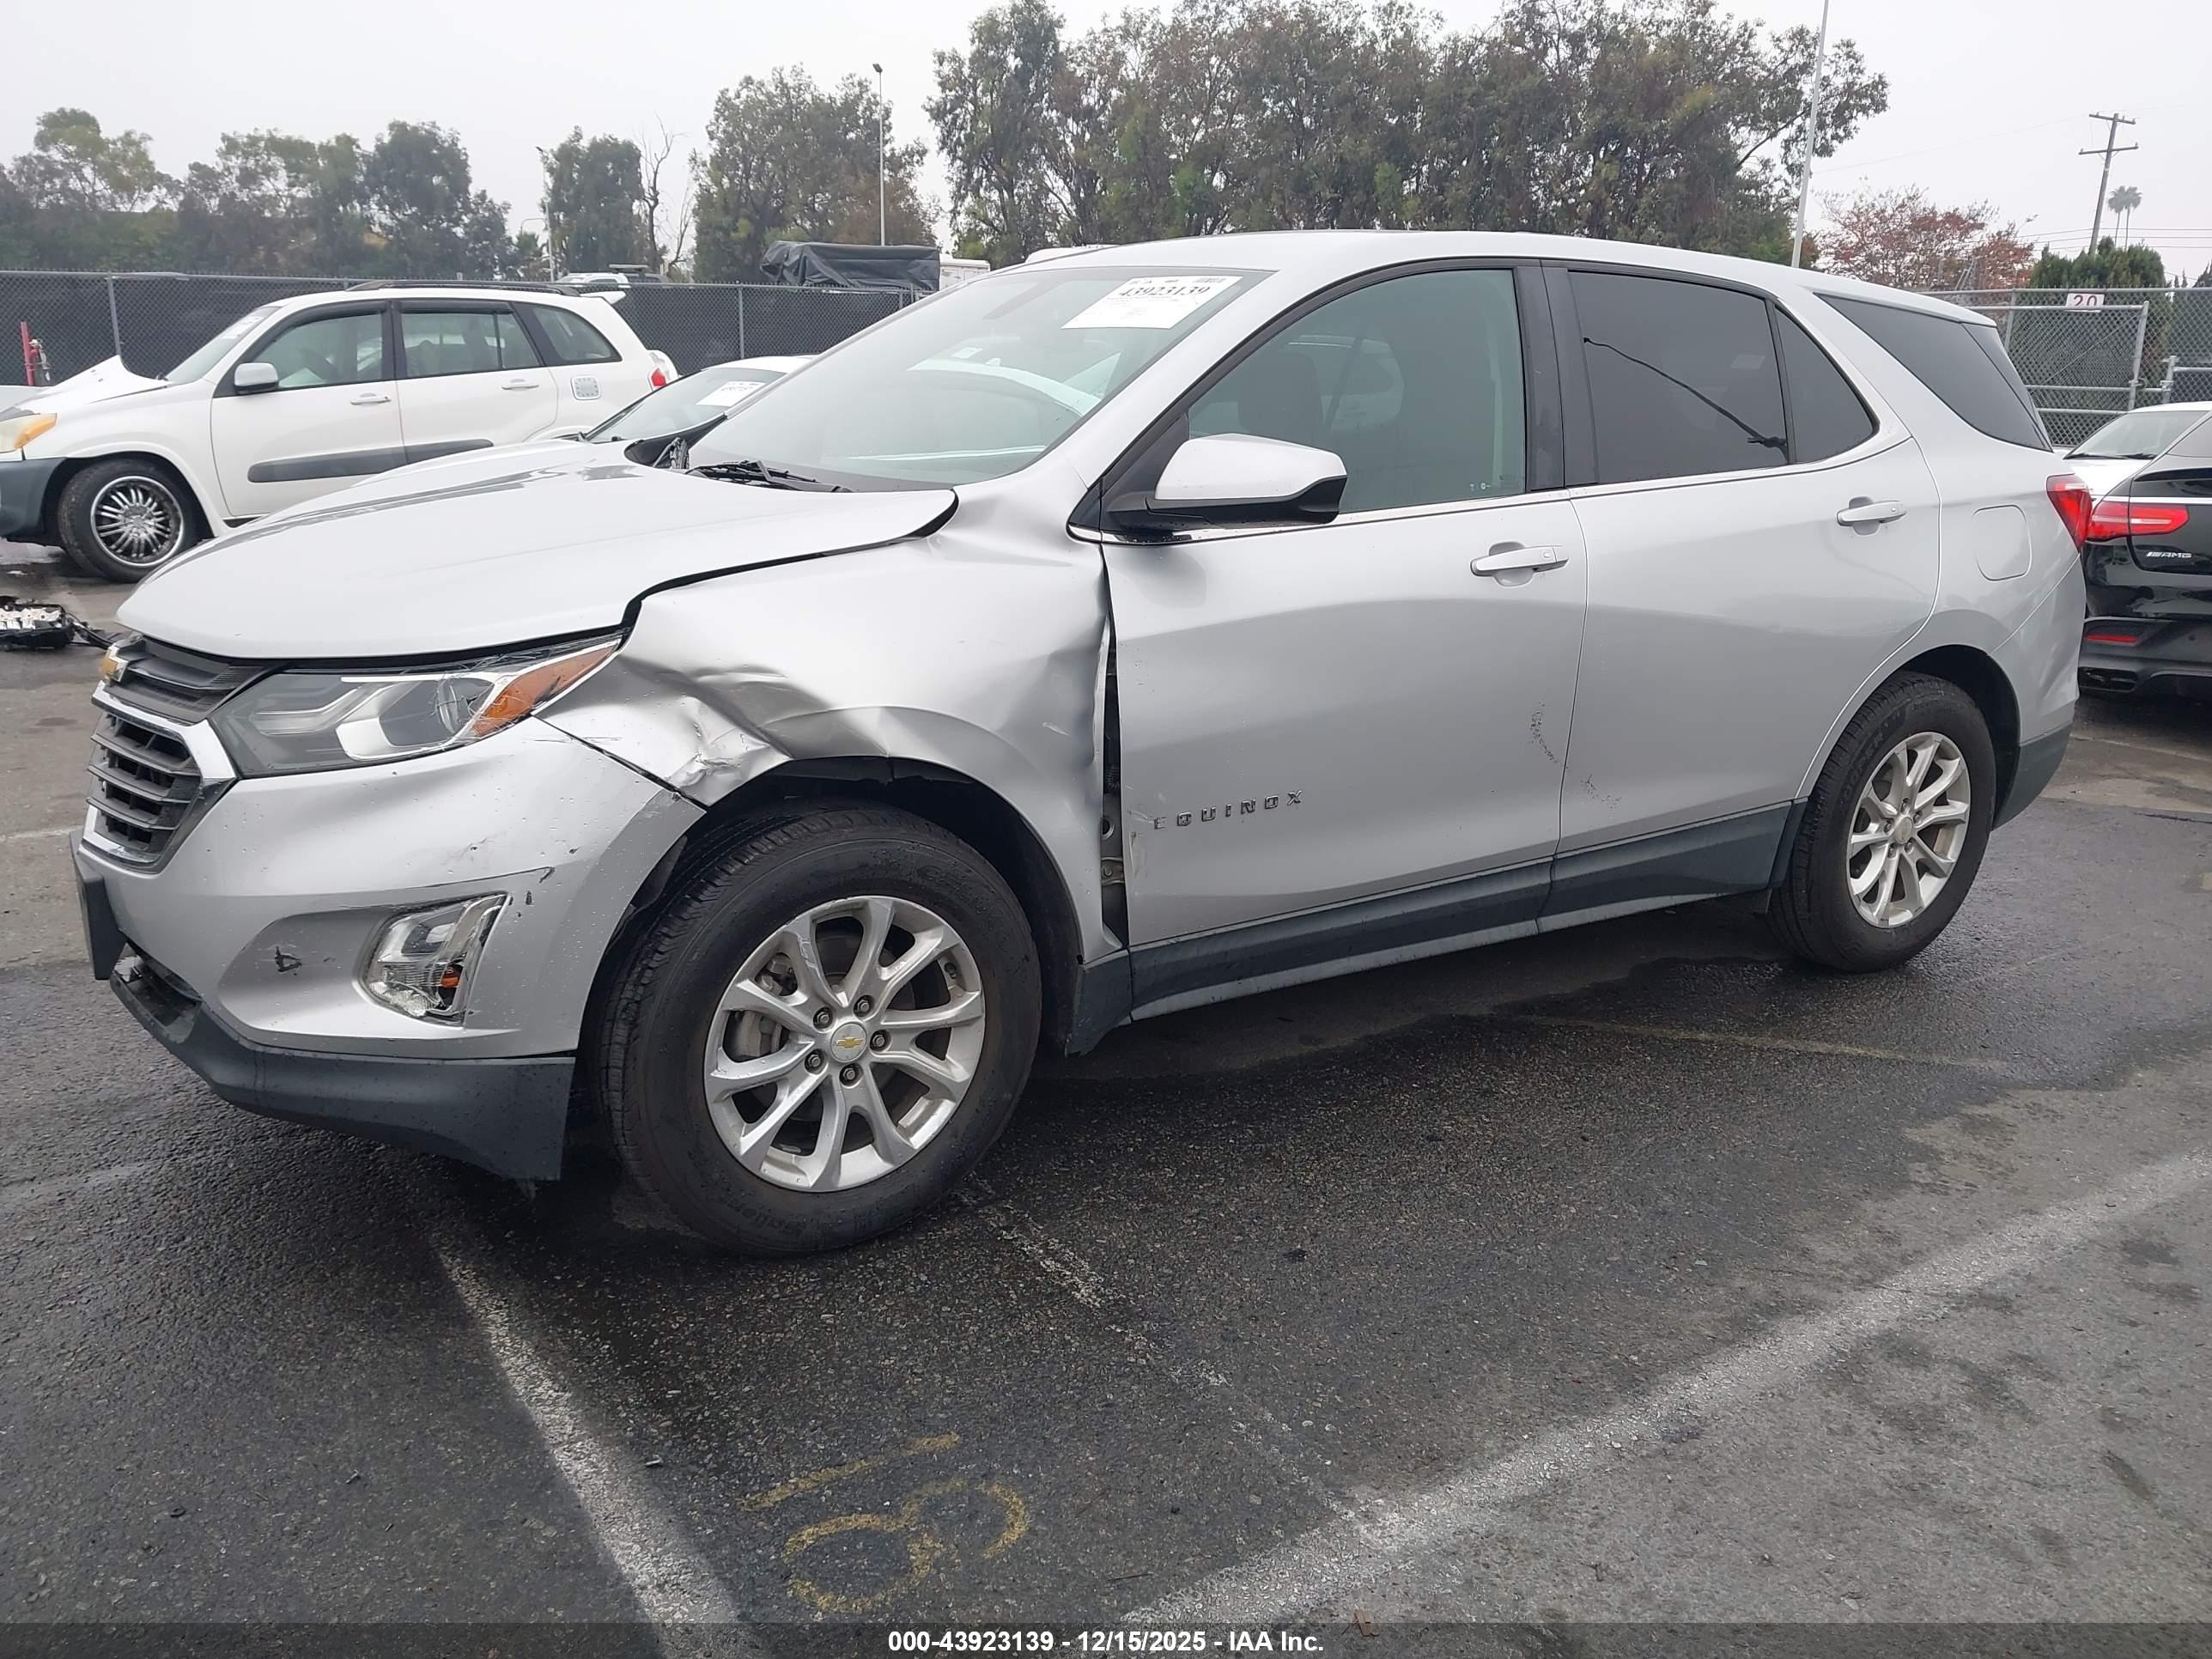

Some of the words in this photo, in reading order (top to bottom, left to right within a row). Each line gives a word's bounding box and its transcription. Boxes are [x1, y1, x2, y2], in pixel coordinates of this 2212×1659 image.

[1119, 286, 1211, 297] 43923139
[2074, 295, 2097, 307] 20
[1153, 789, 1303, 830] EQUINOX
